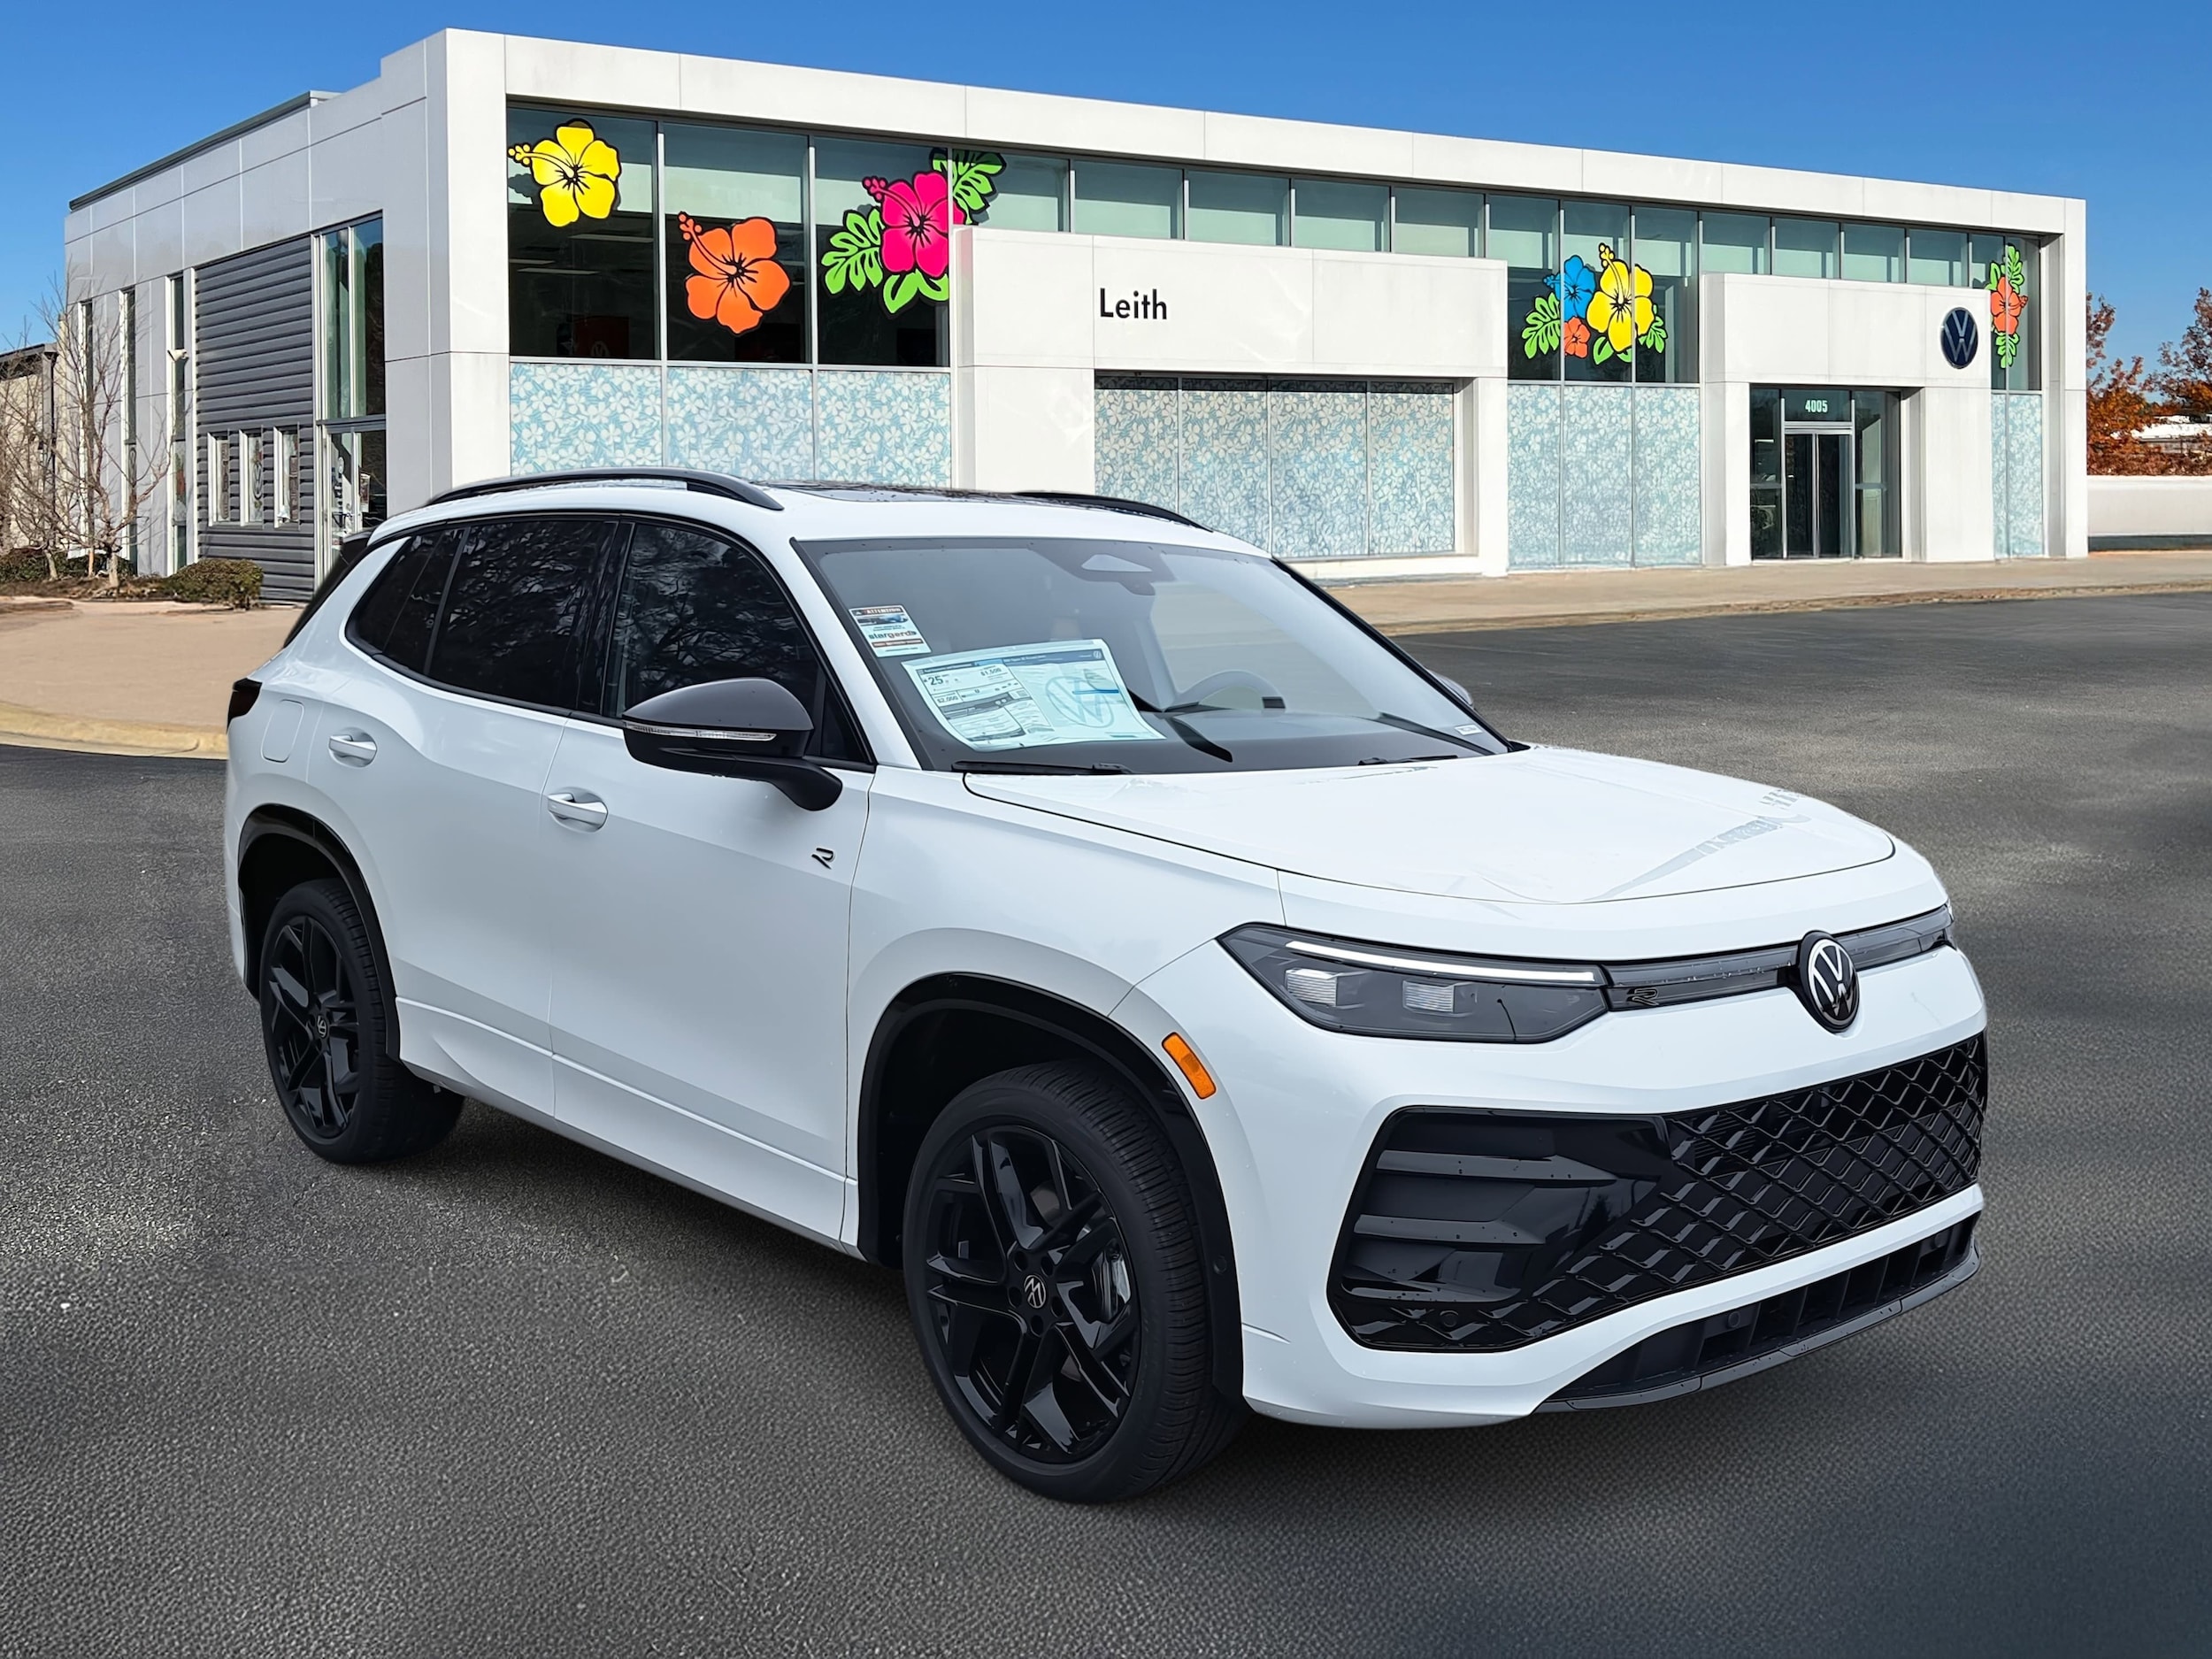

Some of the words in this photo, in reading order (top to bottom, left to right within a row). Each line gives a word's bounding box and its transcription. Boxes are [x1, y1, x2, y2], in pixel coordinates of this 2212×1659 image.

[1100, 288, 1167, 319] Leith
[1941, 307, 1978, 369] VW
[1805, 399, 1828, 413] 4005
[928, 675, 944, 686] 25
[1808, 938, 1858, 1026] VW
